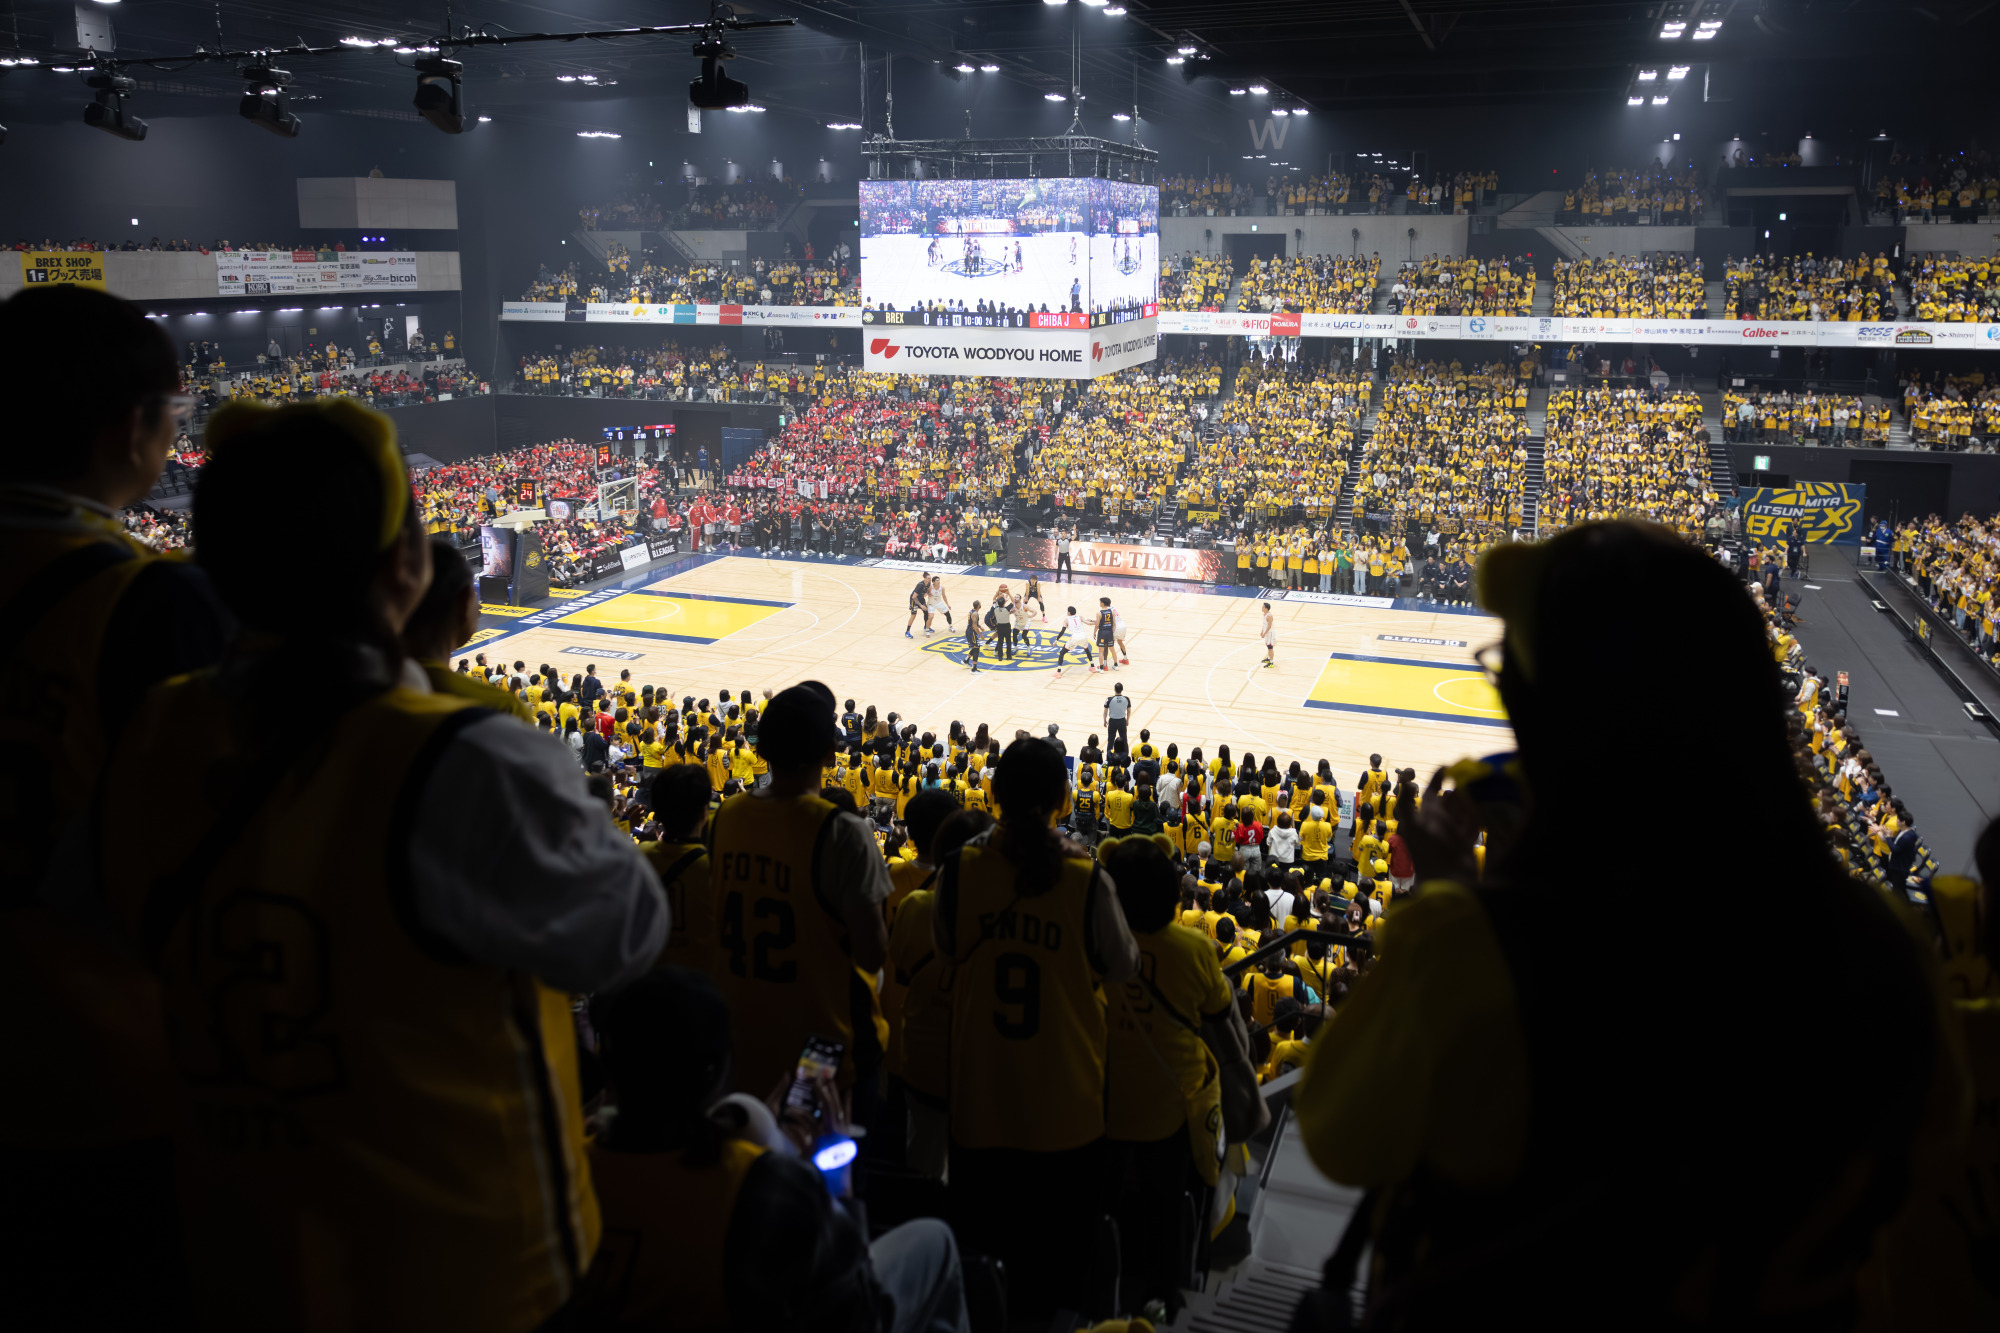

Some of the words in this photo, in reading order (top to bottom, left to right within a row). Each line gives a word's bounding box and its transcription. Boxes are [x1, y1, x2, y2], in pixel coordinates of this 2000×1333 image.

[1248, 119, 1290, 150] W
[35, 258, 62, 267] BREX
[66, 258, 92, 267] SHOP
[29, 270, 45, 282] 1F
[49, 269, 102, 281] グッズ売場
[390, 274, 417, 282] bicoh
[885, 312, 904, 323] BREX
[923, 312, 930, 325] 0
[964, 316, 982, 325] 10:00
[1016, 315, 1023, 327] 0
[1038, 315, 1061, 326] CHIBA
[1064, 315, 1069, 326] J
[1251, 320, 1269, 330] FKD
[1333, 321, 1362, 329] UACJ
[1742, 328, 1778, 338] Calbee
[1857, 327, 1894, 336] RISE
[1105, 343, 1122, 357] TOYOTA
[1143, 335, 1156, 347] HOME
[905, 346, 959, 359] TOYOTA
[964, 347, 1034, 361] WOODYOU
[1040, 350, 1082, 362] HOME
[599, 453, 609, 465] 24
[521, 490, 532, 500] 24
[1751, 504, 1805, 516] UTSUN
[652, 545, 676, 558] B.LEAGUE
[603, 560, 622, 571] SoftBank
[1072, 547, 1122, 568] AME
[1129, 551, 1187, 573] TIME
[518, 588, 628, 624] UTSUNOMIYA
[1384, 635, 1443, 645] B.LEAGUE
[848, 720, 852, 729] 6
[1079, 798, 1091, 808] 25
[1194, 827, 1201, 839] 6
[1220, 827, 1232, 843] 10
[1248, 830, 1255, 843] 2
[722, 853, 790, 892] FOTU
[1376, 890, 1383, 905] 6
[721, 891, 797, 983] 42
[979, 911, 1061, 951] ENDO
[994, 952, 1040, 1039] 9
